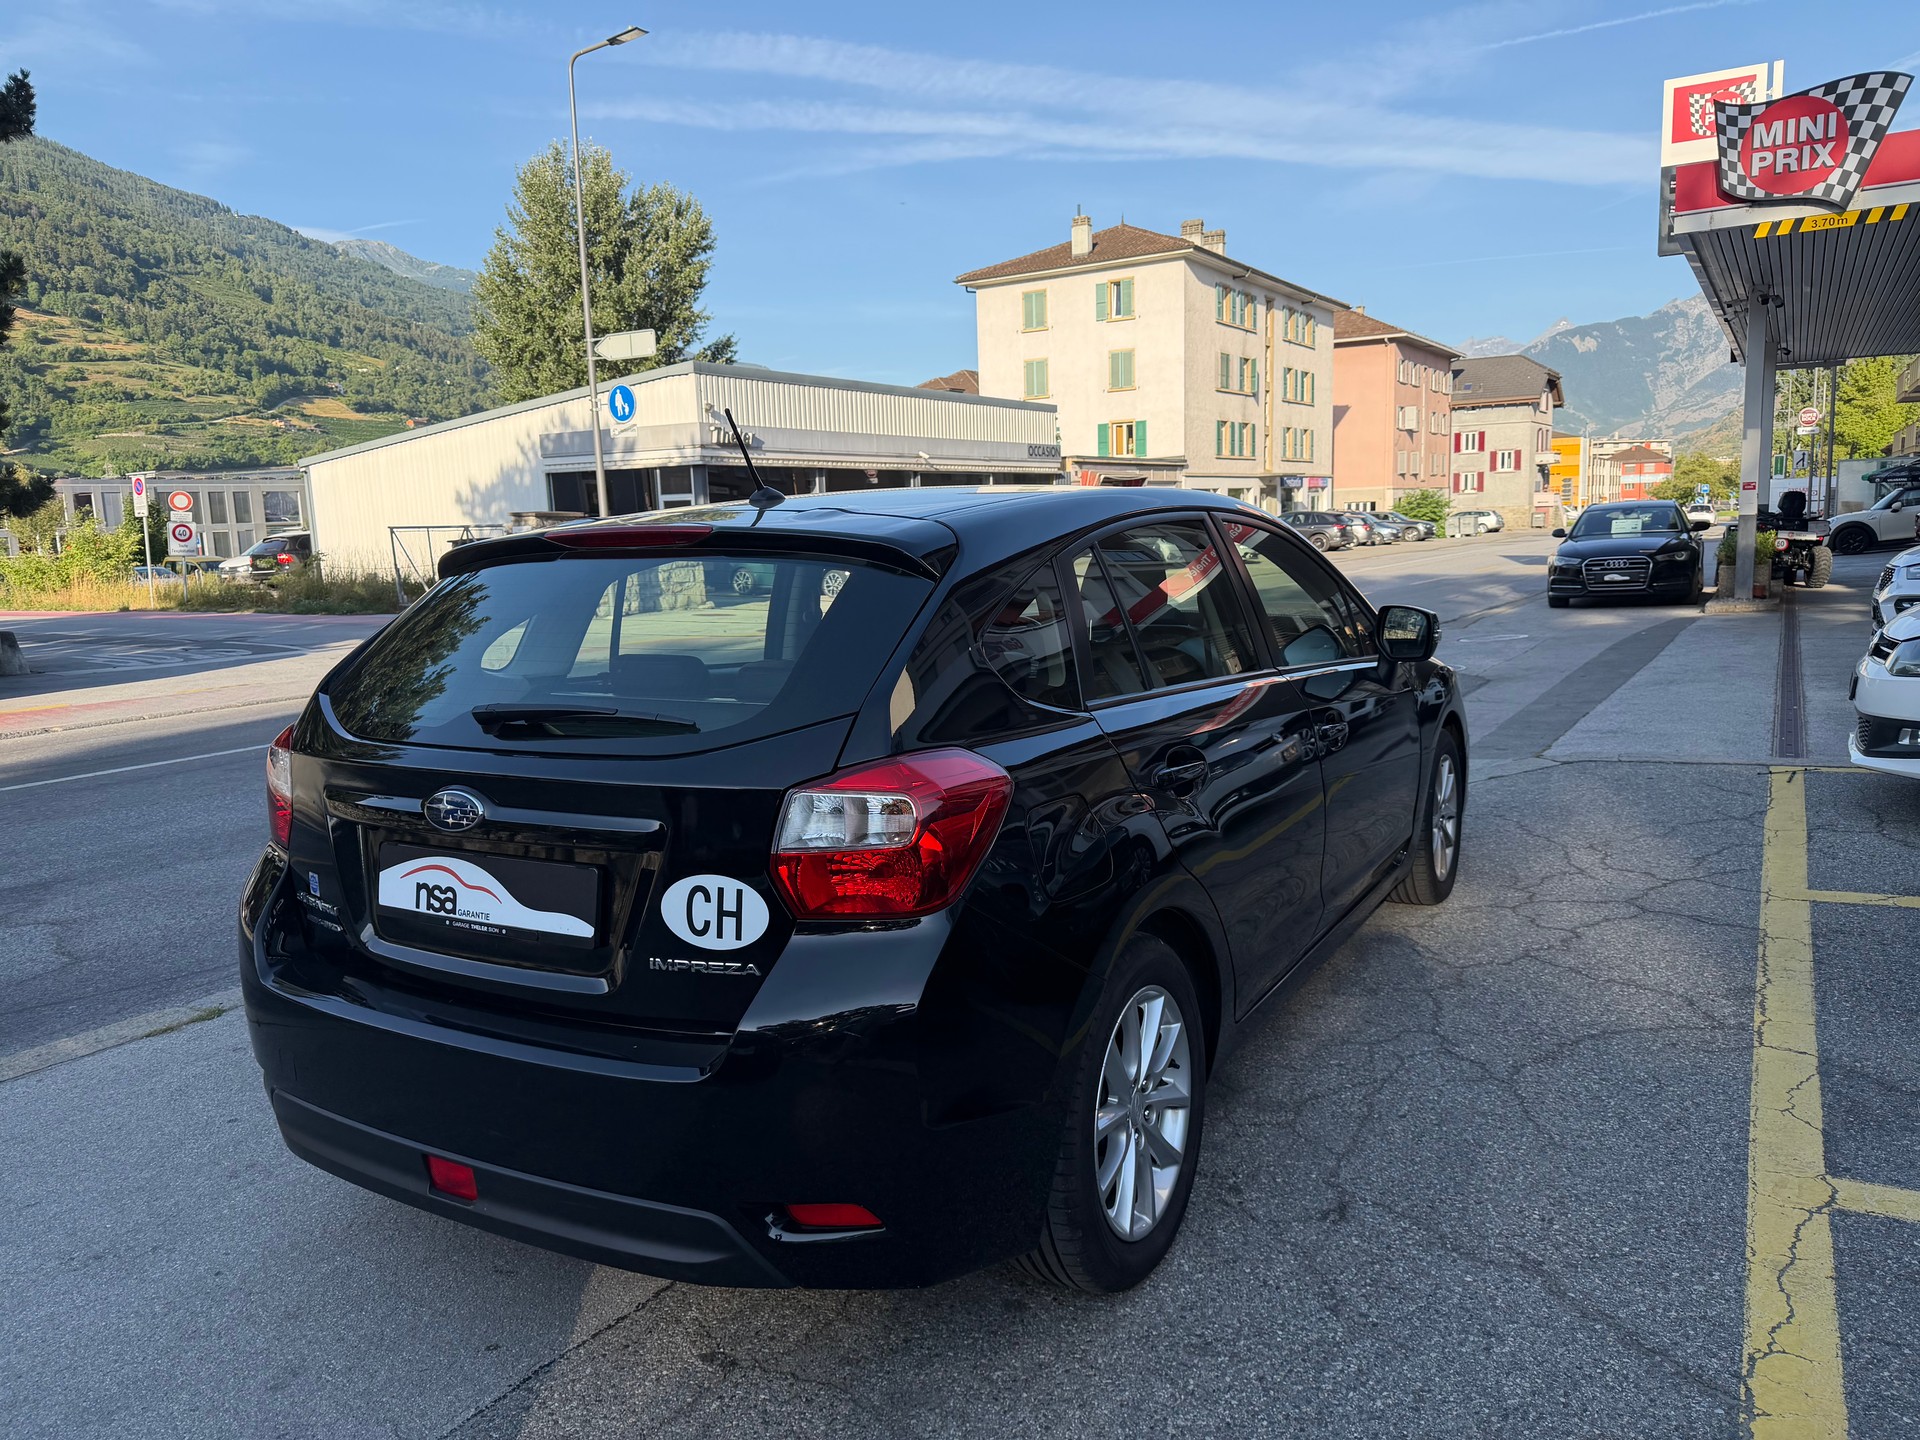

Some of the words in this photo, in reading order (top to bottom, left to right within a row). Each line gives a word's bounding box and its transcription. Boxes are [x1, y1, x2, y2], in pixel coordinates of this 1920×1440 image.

[1752, 111, 1838, 149] MINI
[1750, 141, 1837, 177] PRIX
[1028, 445, 1061, 457] OCCASION
[178, 529, 187, 537] 40
[415, 881, 457, 915] nsa
[457, 908, 491, 921] GARANTIE
[686, 884, 744, 942] CH
[452, 920, 470, 929] GARAGE
[470, 923, 488, 932] THELER
[488, 926, 500, 934] SION
[649, 957, 762, 977] IMPREZA
